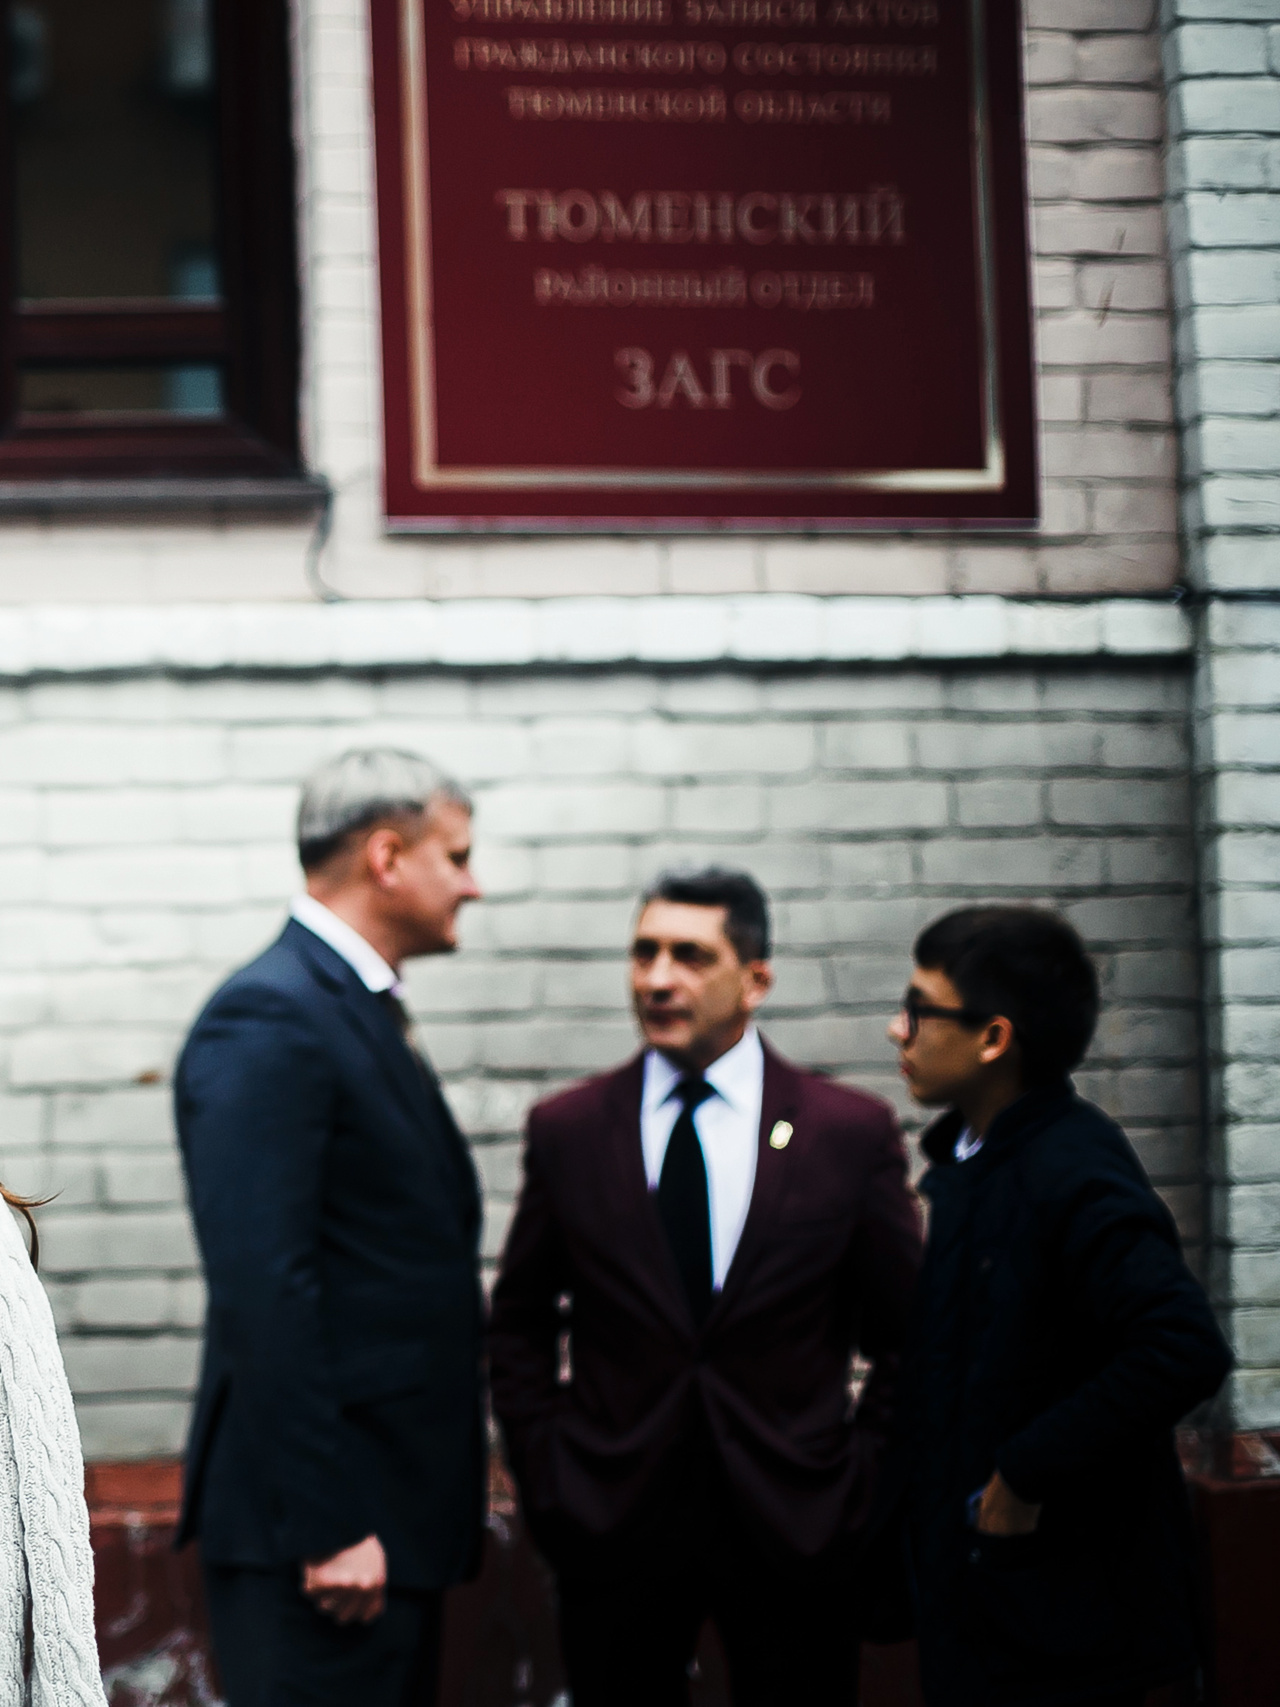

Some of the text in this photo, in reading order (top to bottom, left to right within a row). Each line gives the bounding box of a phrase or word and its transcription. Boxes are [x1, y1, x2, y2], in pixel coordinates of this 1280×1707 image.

[508, 86, 891, 123] ТЮМЕНСКОЙ ОБЛАСТИ
[495, 184, 905, 243] ТЮМЕНСКИЙ
[750, 271, 875, 310] ОТДЕЛ
[614, 347, 801, 410] ЗАГС
